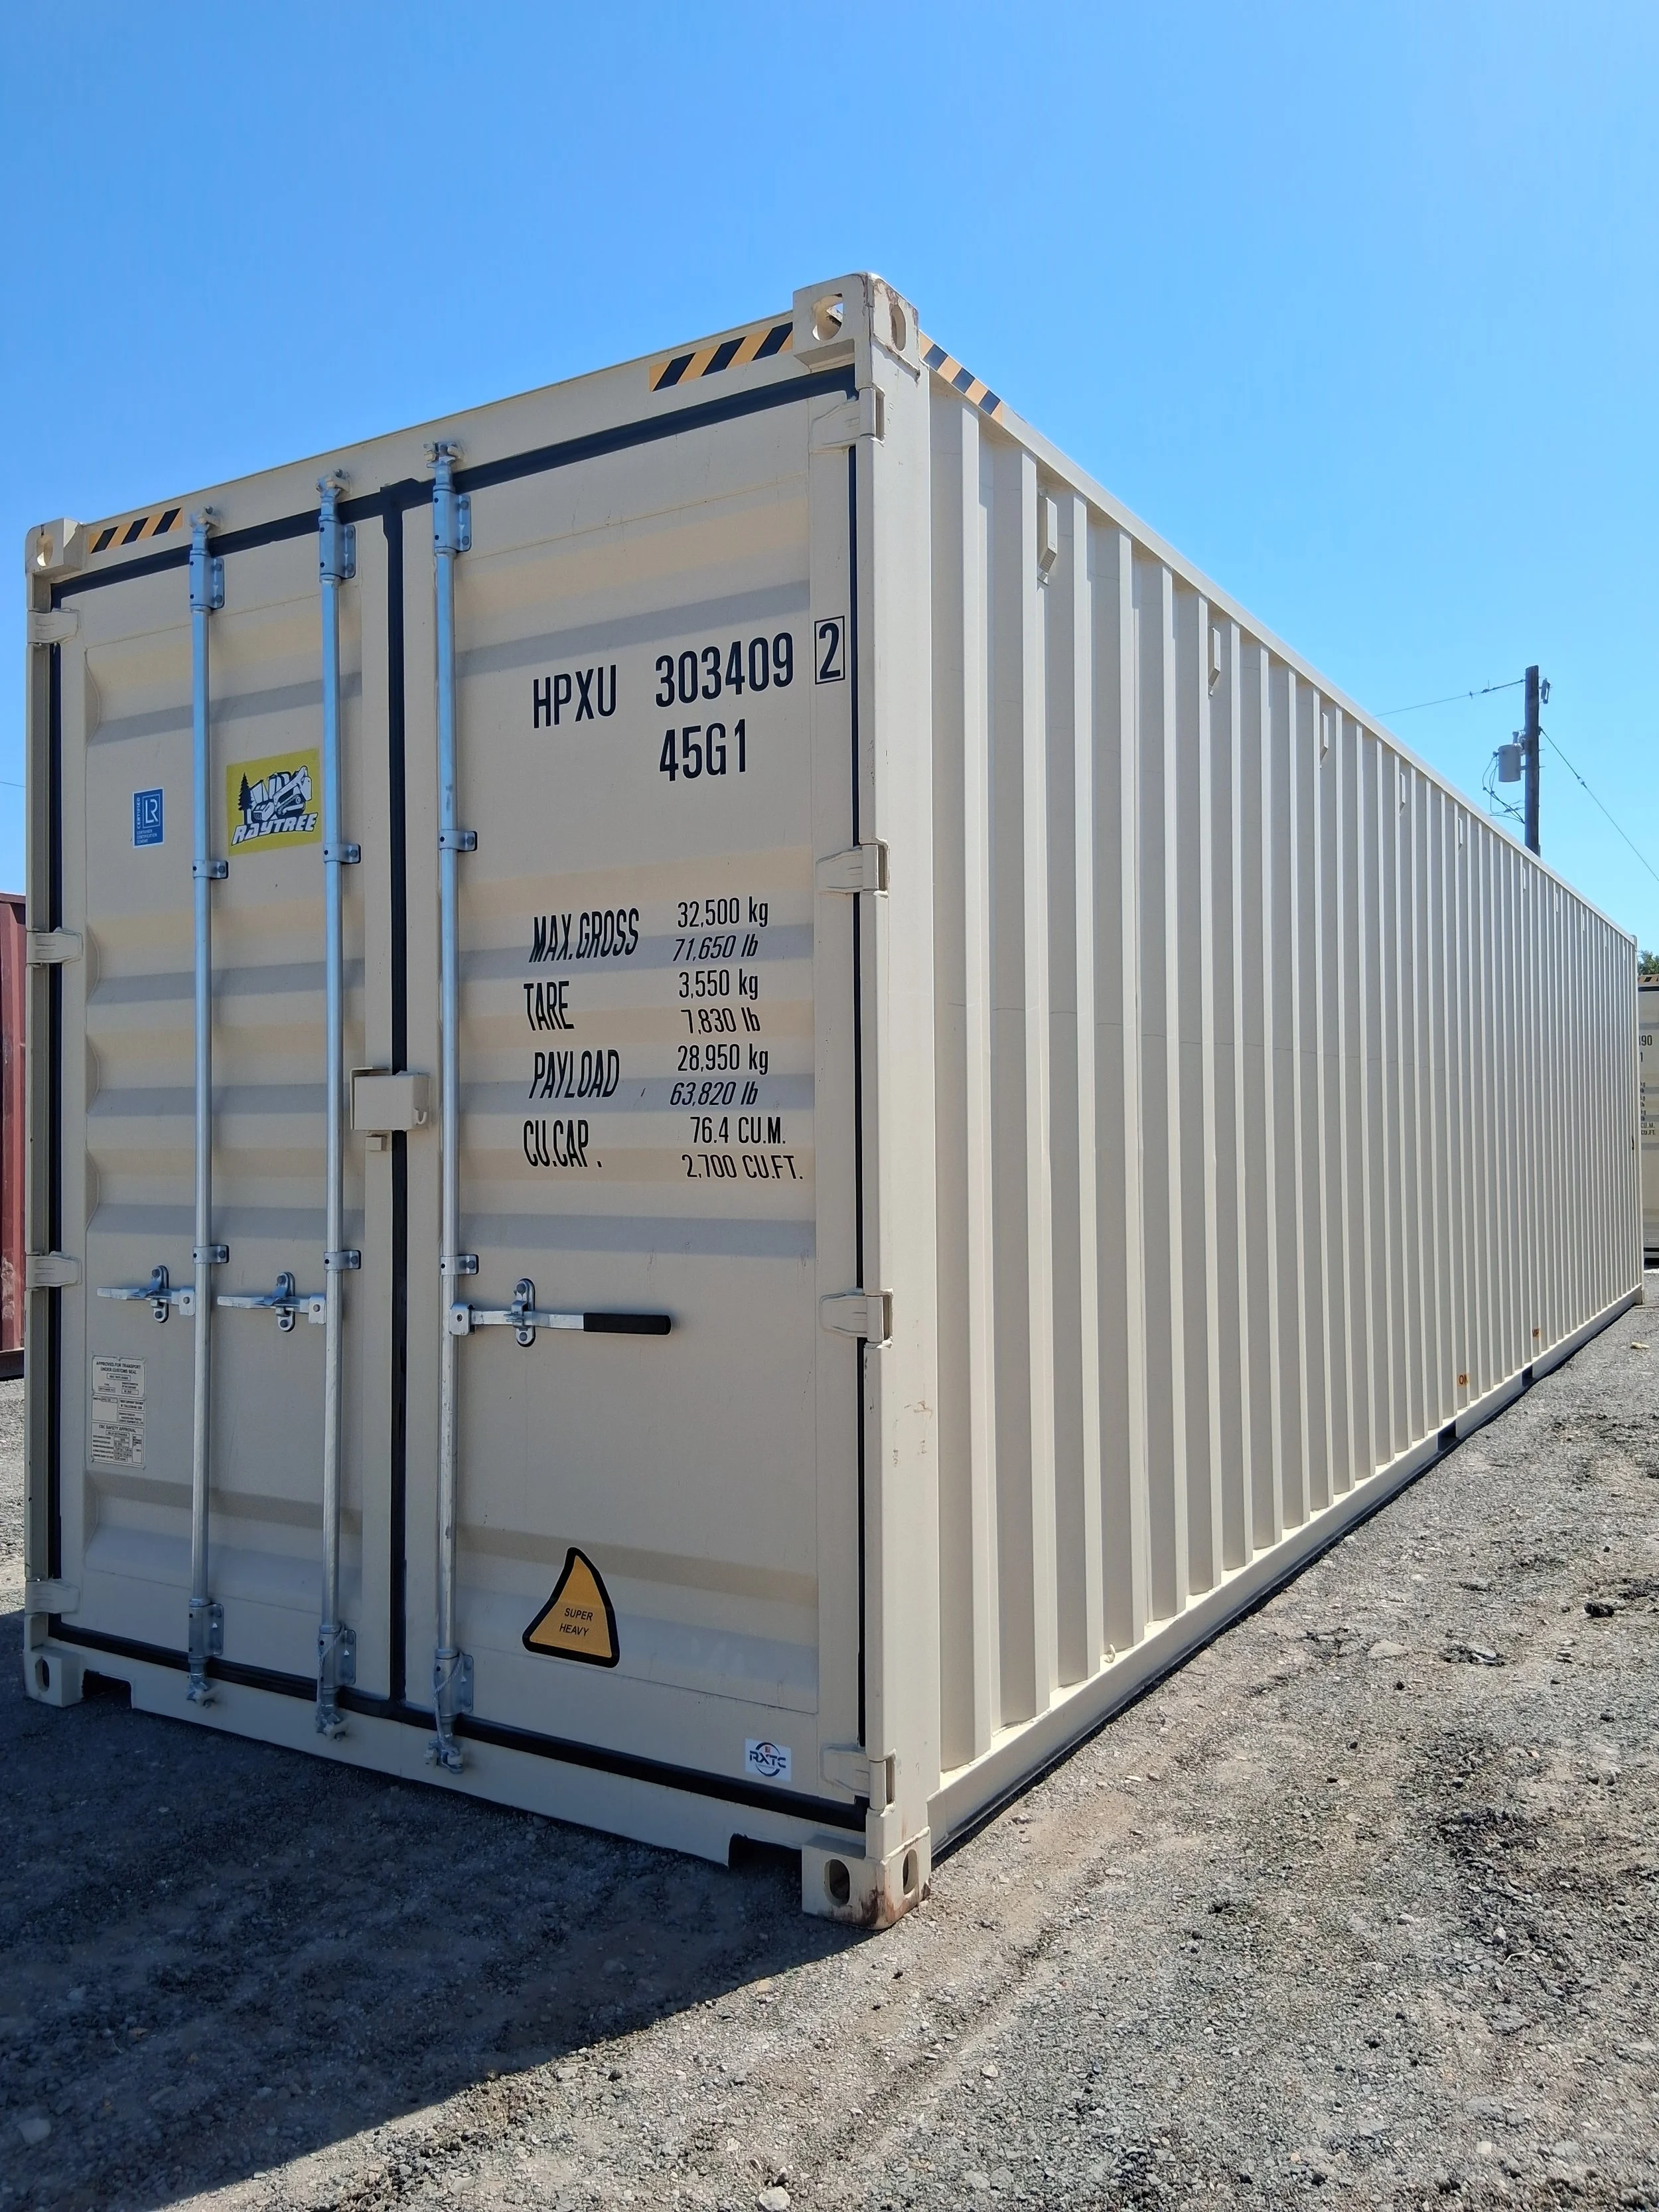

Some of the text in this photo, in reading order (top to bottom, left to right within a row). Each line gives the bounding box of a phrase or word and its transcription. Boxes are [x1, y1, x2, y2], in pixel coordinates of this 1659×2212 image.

[533, 623, 841, 729] HPXU 303409 2
[659, 719, 747, 782] 45G1
[231, 812, 319, 846] RAYTREE
[528, 896, 768, 963] MAX.GROSS 32,500 kg
[672, 933, 758, 962] 71,650 lb
[524, 968, 758, 1031] TARE 3,550 kg
[680, 1007, 761, 1034] 7,830 lb
[528, 1043, 768, 1099] PAYLOAD 28,950 kg
[670, 1080, 758, 1106] 63,820 lb
[689, 1116, 729, 1143] 76.4
[738, 1116, 786, 1144] CU.M.
[742, 1154, 804, 1180] CU.FT.
[564, 1607, 593, 1621] SUPER
[559, 1623, 589, 1637] HEAVY
[749, 1750, 786, 1769] RXTC
